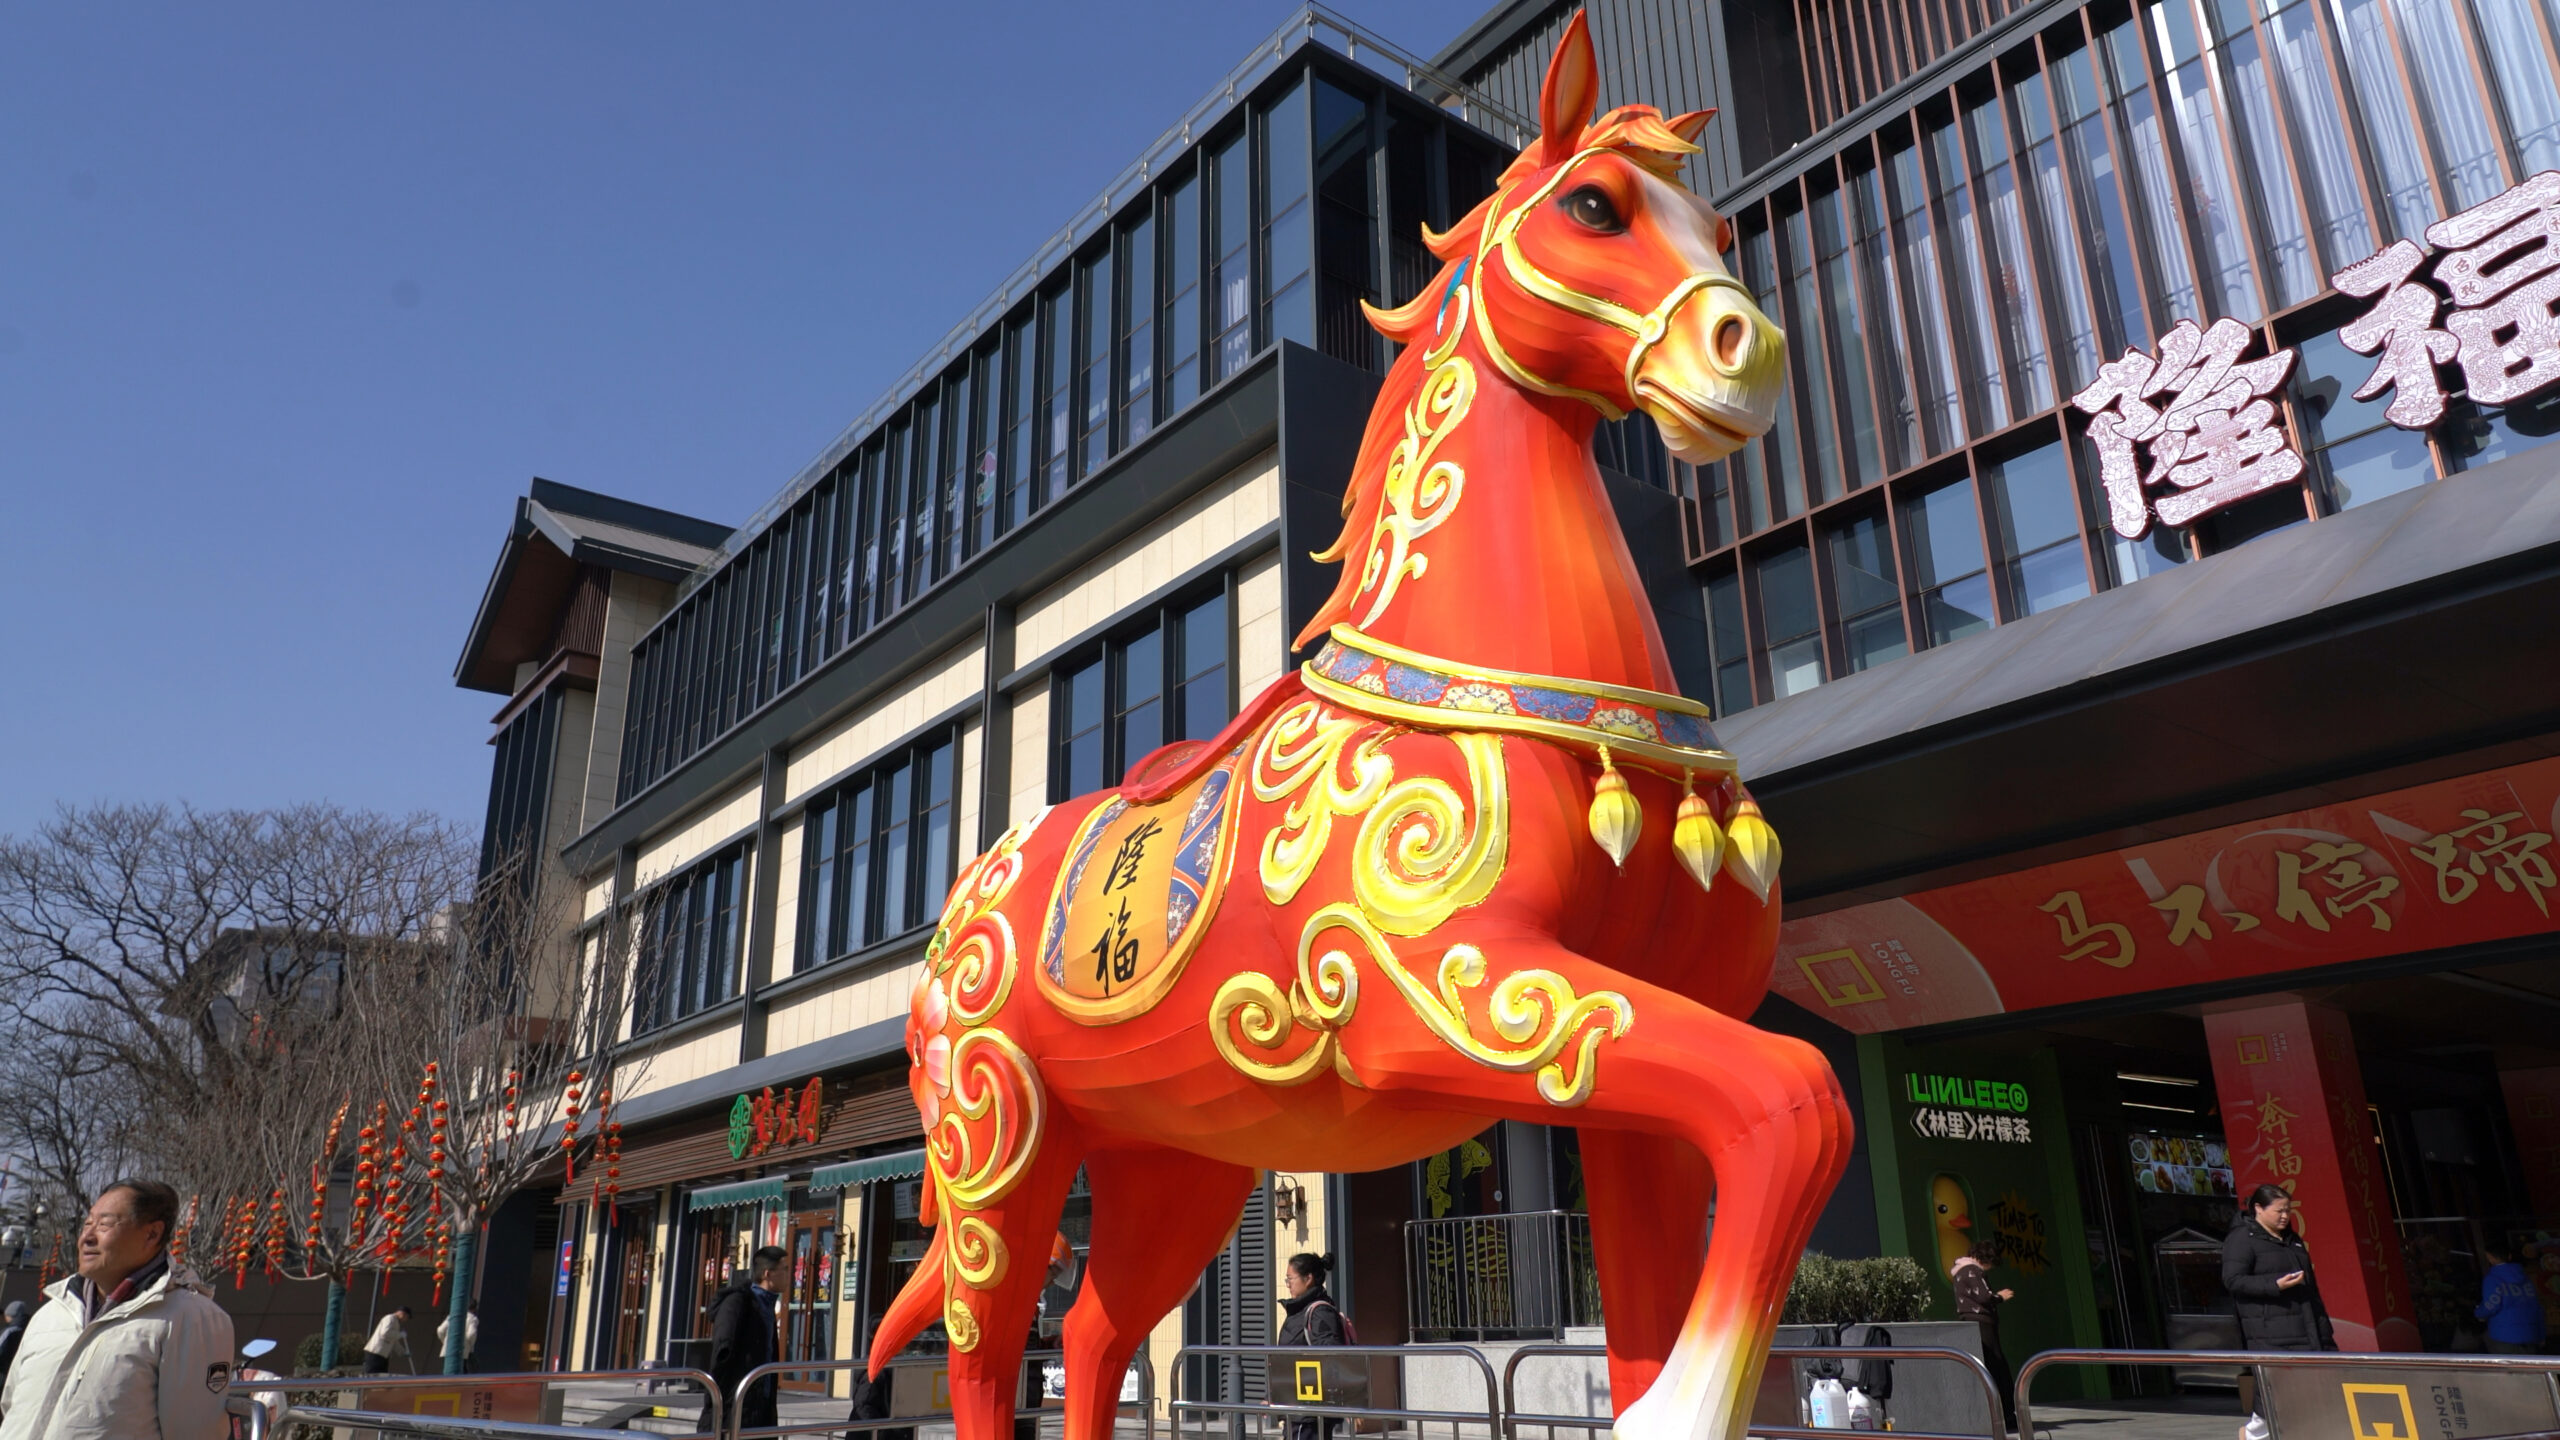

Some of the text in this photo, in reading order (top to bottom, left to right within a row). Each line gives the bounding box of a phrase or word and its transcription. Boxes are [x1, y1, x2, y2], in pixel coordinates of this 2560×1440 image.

[2071, 170, 2560, 541] 隆福
[1091, 817, 1162, 997] 隆福
[2036, 809, 2558, 968] 马不停蹄
[1870, 942, 1916, 995] LONGFU
[1993, 1230, 2051, 1268] BREAK
[2028, 1213, 2045, 1236] TO
